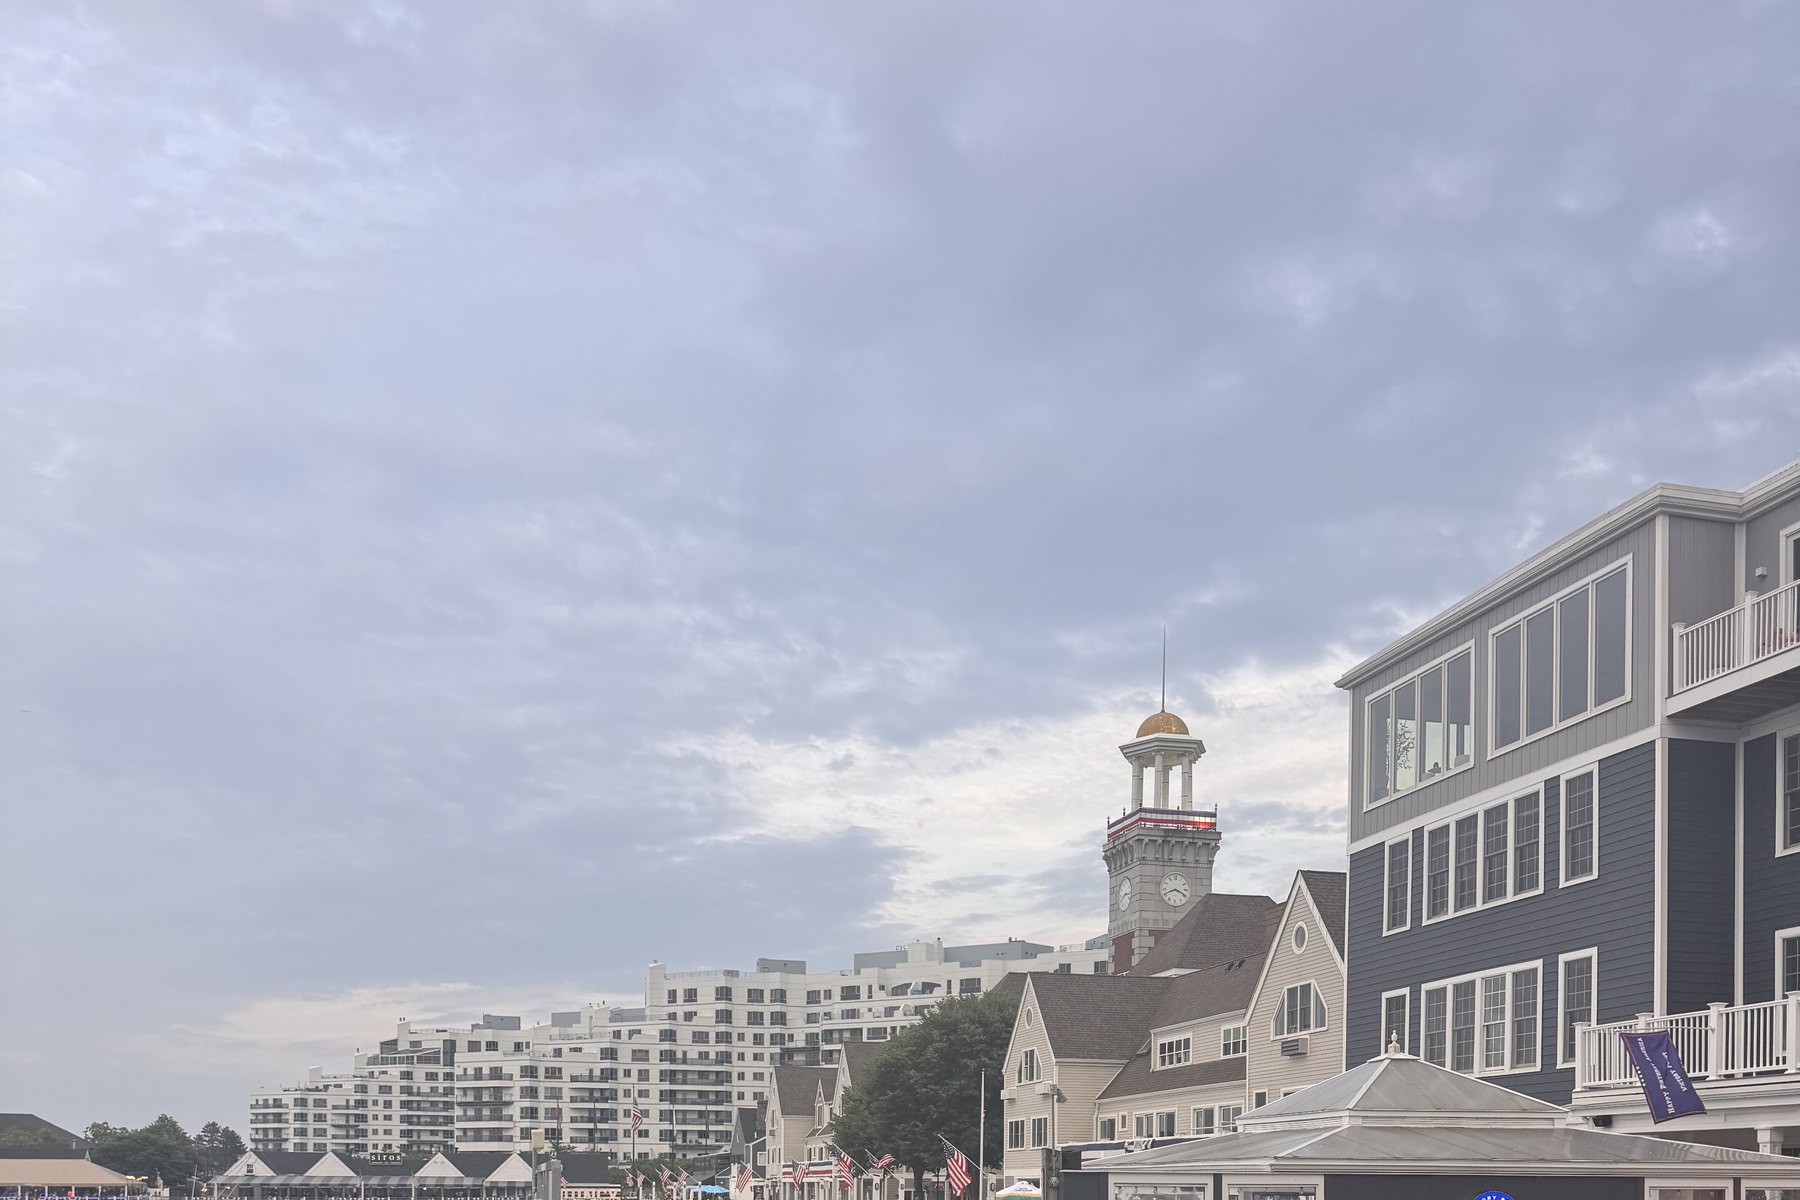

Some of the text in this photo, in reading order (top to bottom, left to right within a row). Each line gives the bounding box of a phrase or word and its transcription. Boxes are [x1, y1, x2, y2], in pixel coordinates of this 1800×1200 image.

[1669, 1069, 1687, 1092] VICTORY
[1663, 1091, 1675, 1114] HAPPY
[371, 1153, 401, 1161] siros
